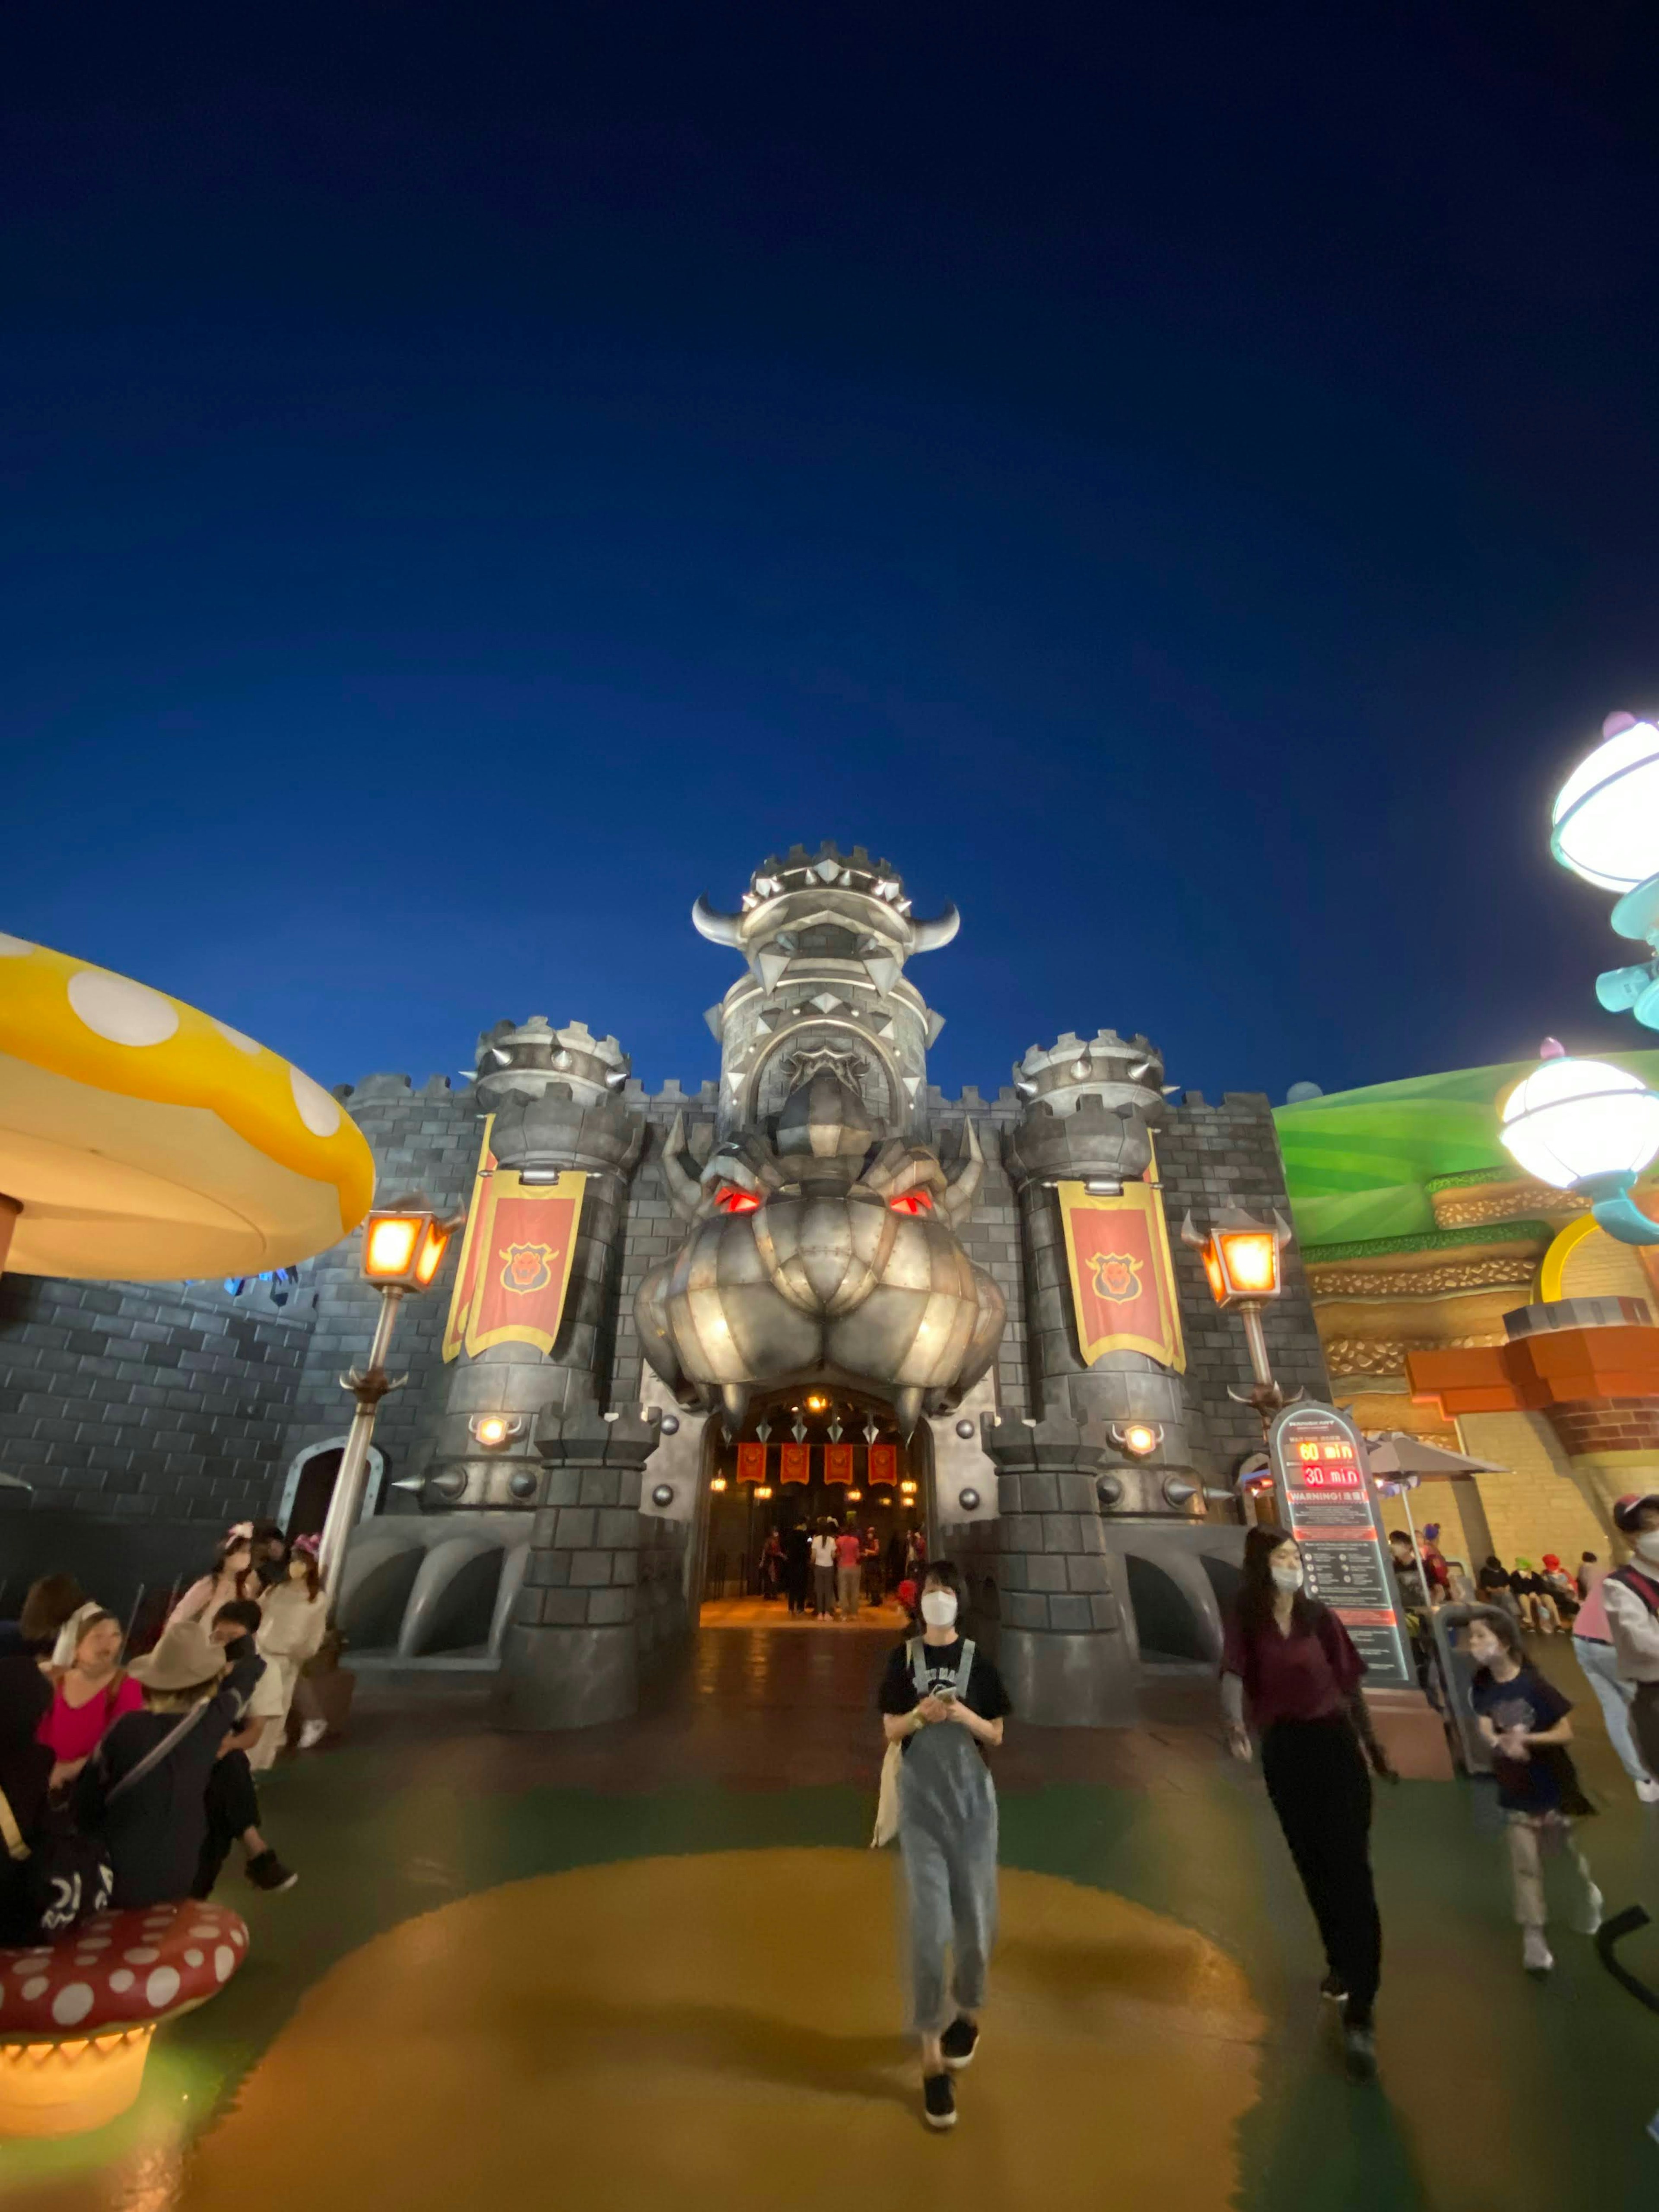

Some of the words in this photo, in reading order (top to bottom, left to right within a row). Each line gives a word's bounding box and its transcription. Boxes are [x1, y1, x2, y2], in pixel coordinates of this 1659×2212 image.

[1300, 1443, 1319, 1460] 60
[1324, 1444, 1353, 1459] min
[1306, 1468, 1324, 1484] 30
[1331, 1469, 1358, 1484] min
[1292, 1492, 1341, 1500] WARNING!
